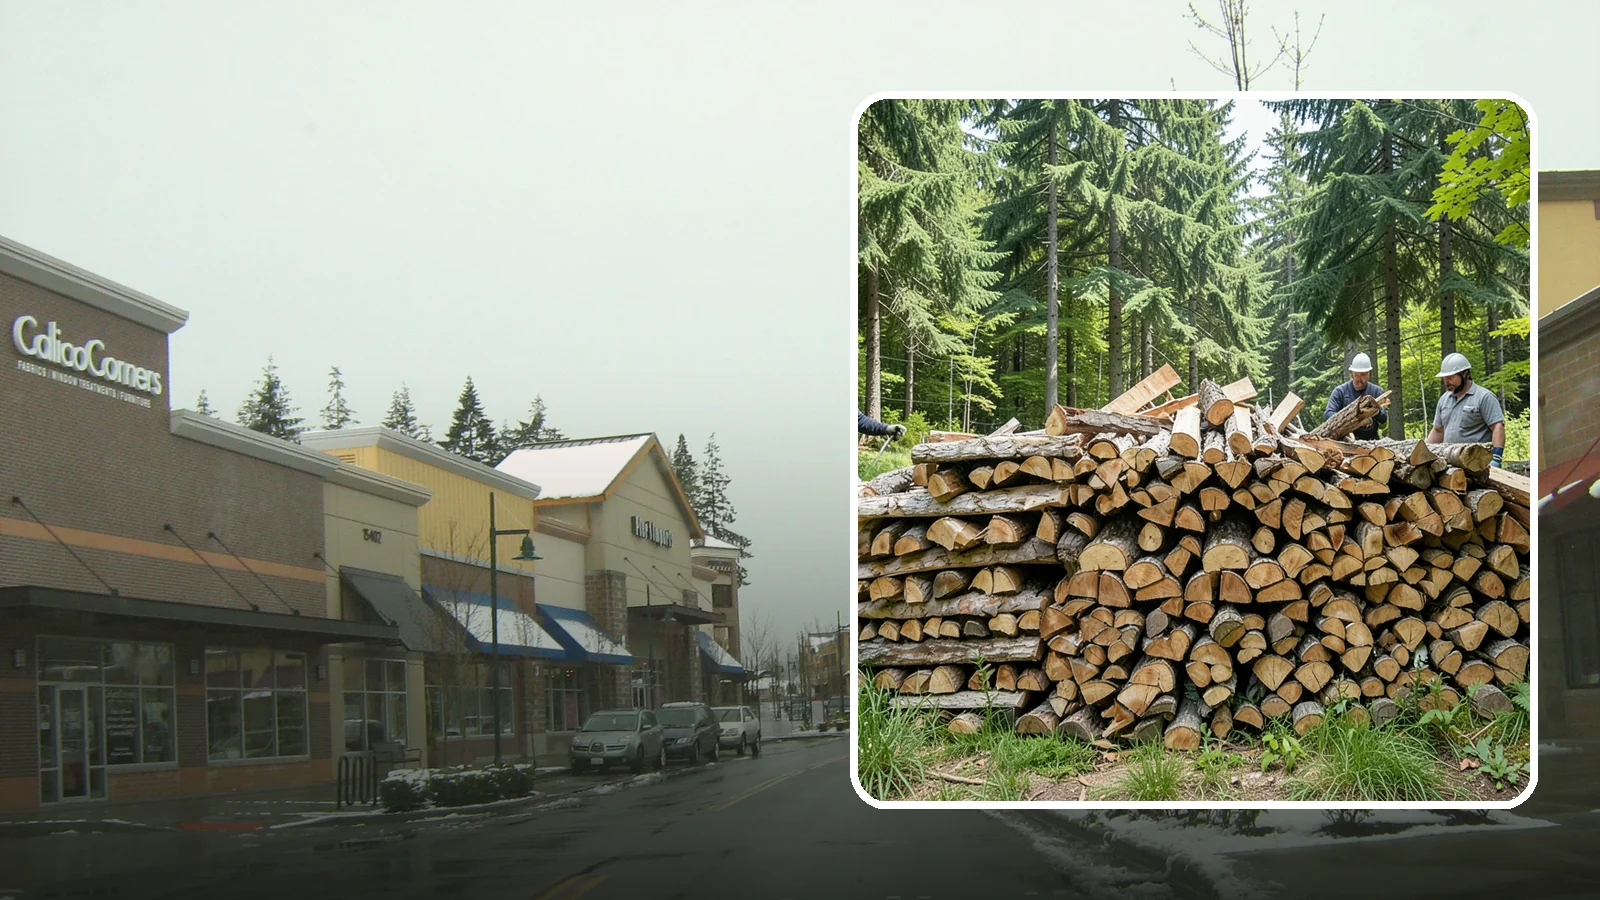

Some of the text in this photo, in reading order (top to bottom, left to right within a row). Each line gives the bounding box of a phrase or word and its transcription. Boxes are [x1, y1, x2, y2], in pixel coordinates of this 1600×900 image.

[17, 360, 47, 377] FABRICS
[51, 370, 78, 386] WINDOW
[78, 379, 117, 398] TREATMENTS
